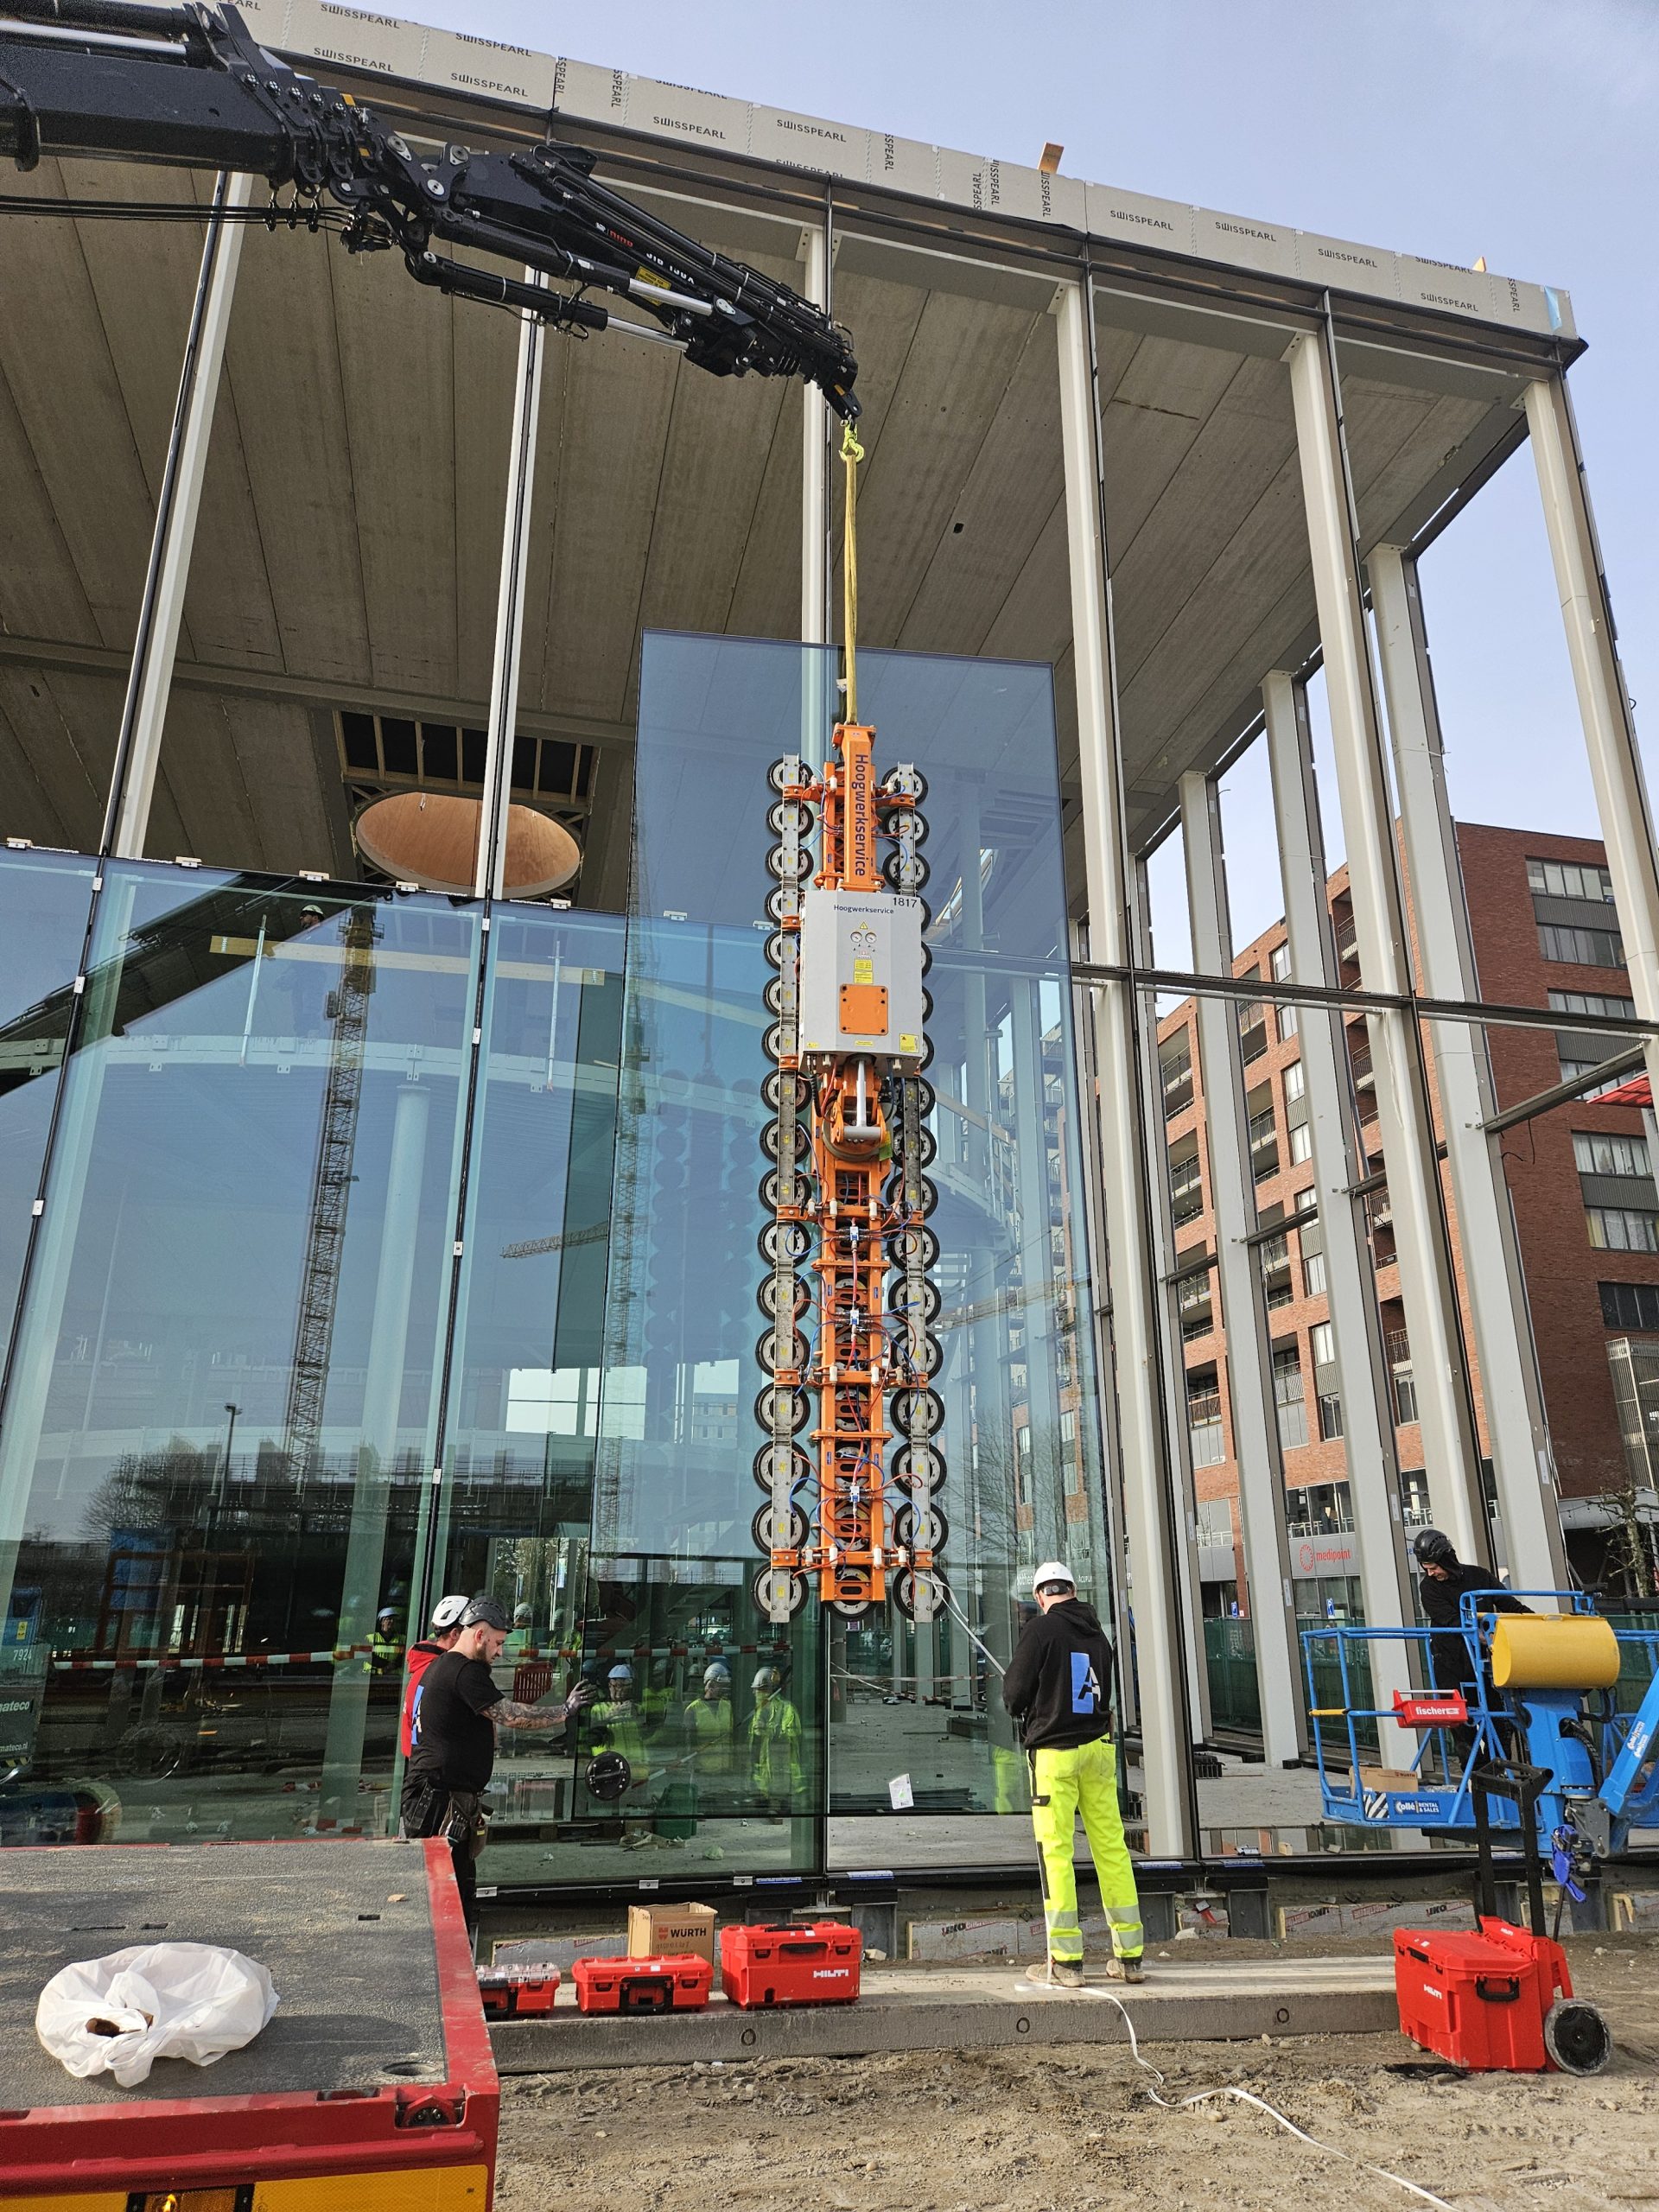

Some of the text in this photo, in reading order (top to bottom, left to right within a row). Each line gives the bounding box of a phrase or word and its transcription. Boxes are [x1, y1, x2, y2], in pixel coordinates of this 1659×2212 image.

[321, 3, 400, 29] SWISSPEARL
[455, 33, 531, 57] SWISSPEARL
[313, 48, 394, 73] SWISSPEARL
[451, 73, 528, 97] SWISSPEARL
[652, 116, 727, 140] SWISSPEARL
[777, 119, 847, 143] SWISSPEARL
[1110, 210, 1173, 231] SWISSPEARL
[1215, 221, 1277, 242] SWISSPEARL
[1318, 248, 1378, 268] SWISSPEARL
[1421, 292, 1478, 312] SWISSPEARL
[851, 754, 869, 876] Hoogwerkservice
[834, 905, 894, 914] Hoogwerkservice
[893, 897, 917, 908] 1817
[1316, 1548, 1351, 1563] medipoint
[1415, 1707, 1446, 1715] fischer
[1395, 1800, 1416, 1814] Collé
[671, 1927, 707, 1938] WÜRTH
[813, 1969, 849, 1978] HILTI
